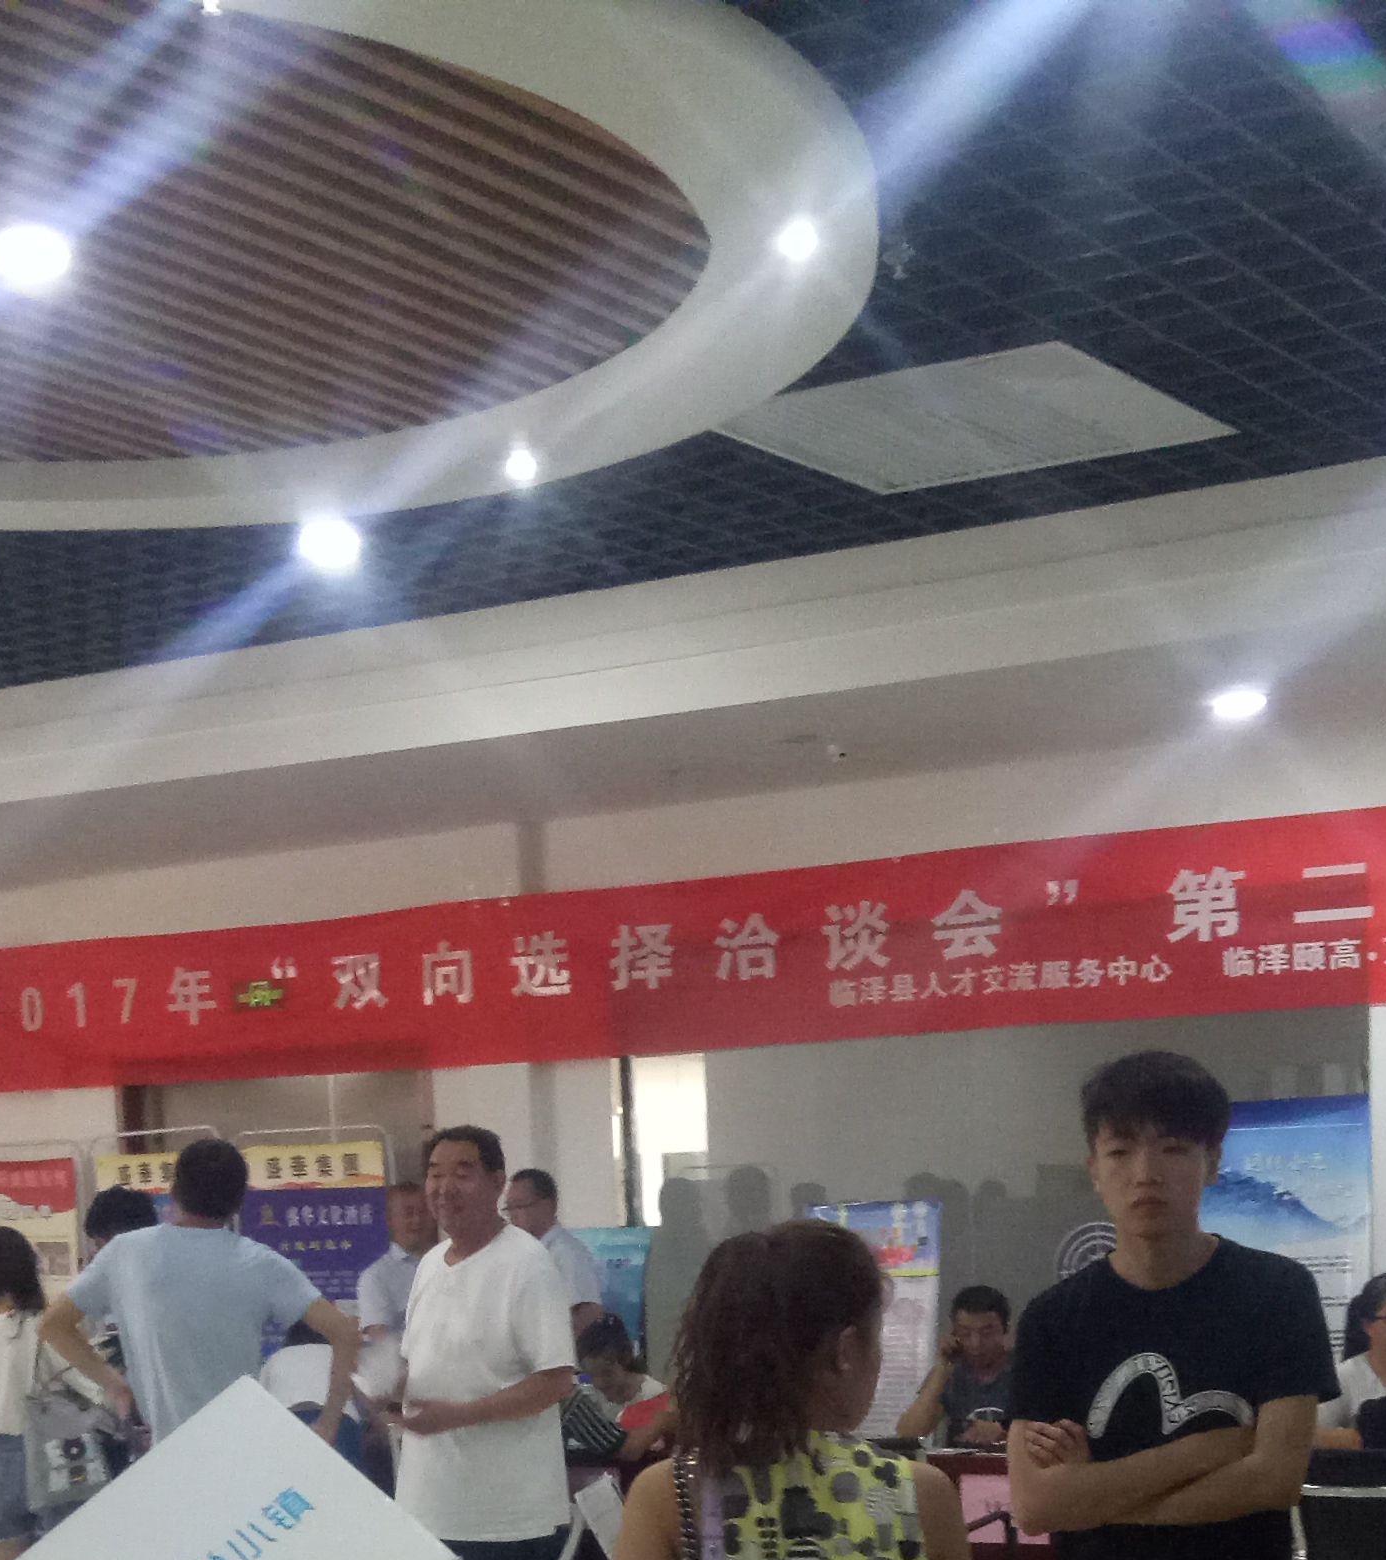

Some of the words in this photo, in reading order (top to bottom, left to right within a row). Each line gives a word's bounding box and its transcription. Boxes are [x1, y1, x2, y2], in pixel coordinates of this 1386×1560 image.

[828, 954, 1173, 1008] 临泽县人才交流服务中心
